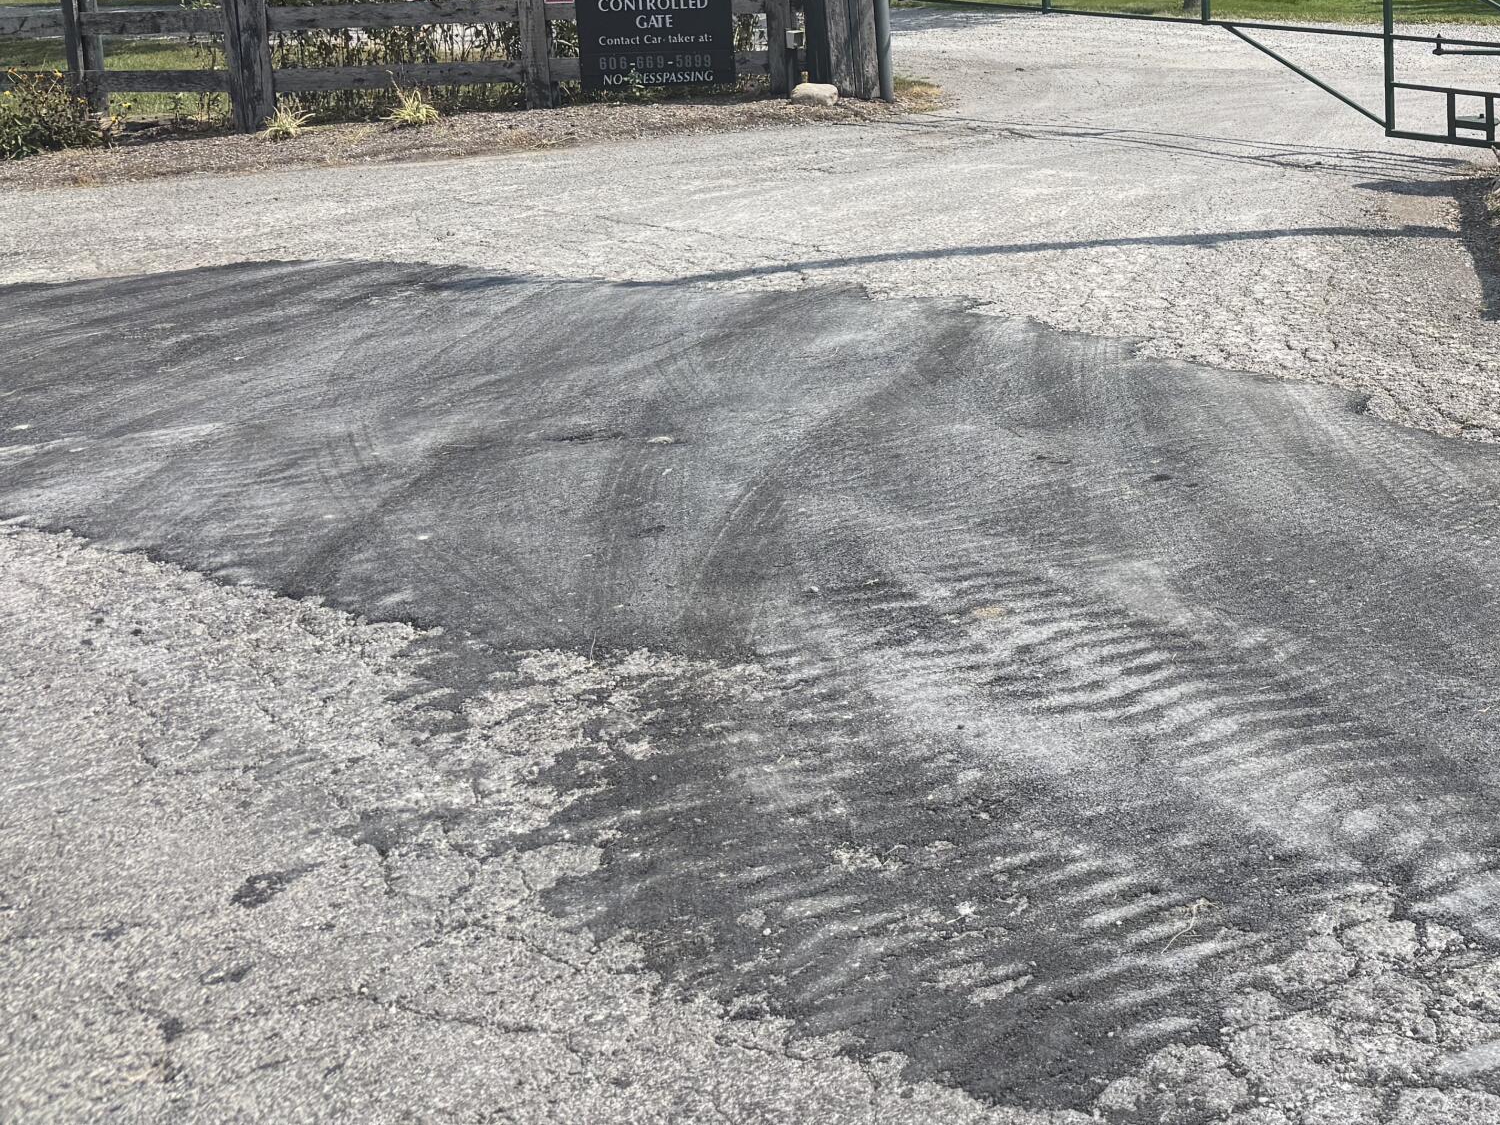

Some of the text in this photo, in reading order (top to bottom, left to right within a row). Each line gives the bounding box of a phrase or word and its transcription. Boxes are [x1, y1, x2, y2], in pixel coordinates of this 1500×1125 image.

[635, 14, 673, 29] GATE
[598, 33, 713, 46] Contact Cartaker at:
[603, 70, 714, 86] NO RESSPASSING
